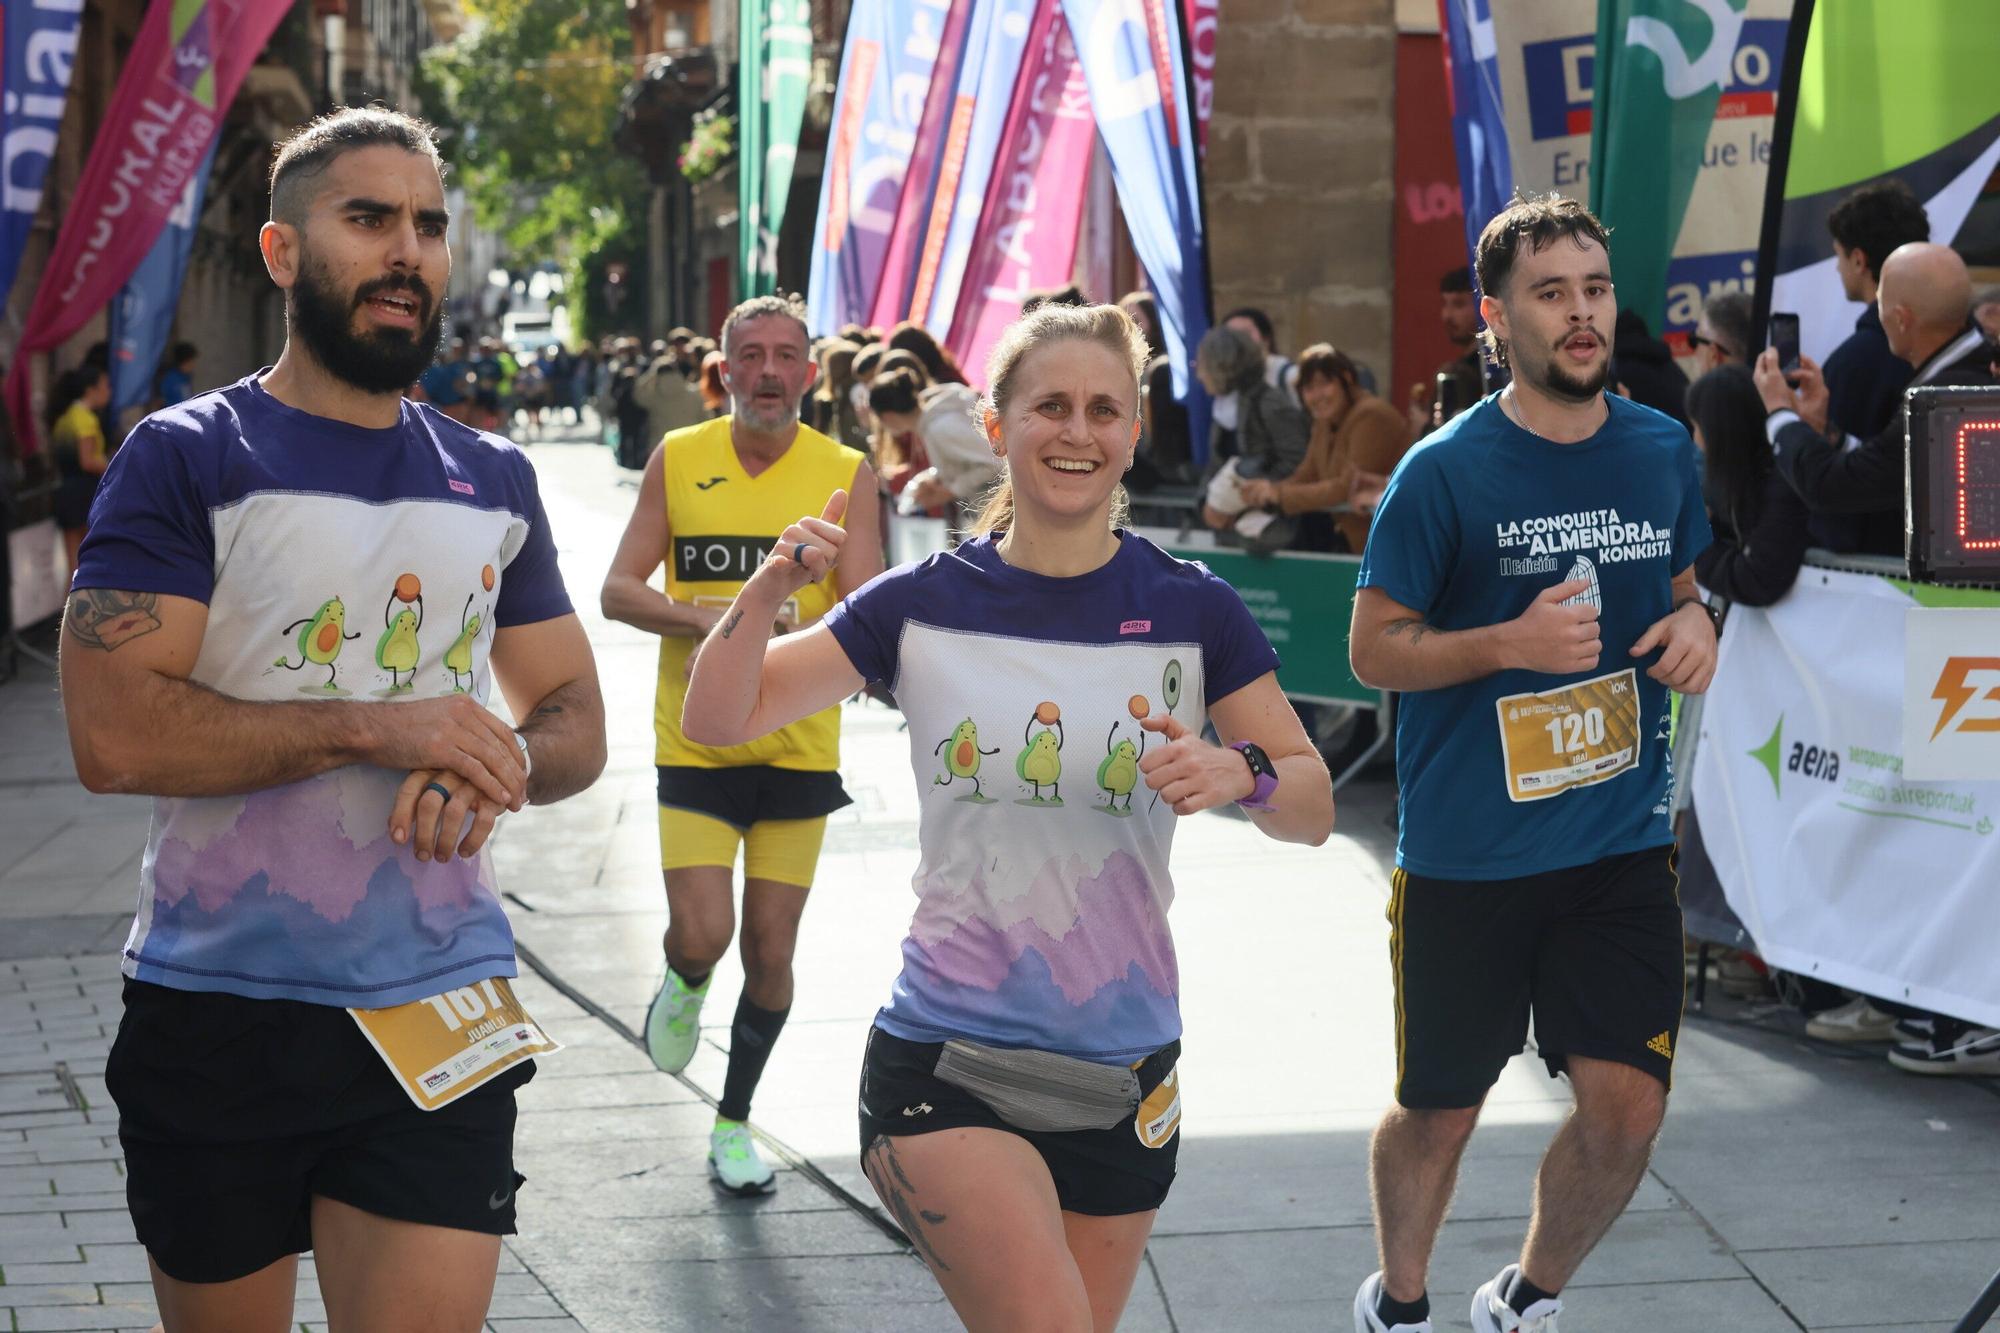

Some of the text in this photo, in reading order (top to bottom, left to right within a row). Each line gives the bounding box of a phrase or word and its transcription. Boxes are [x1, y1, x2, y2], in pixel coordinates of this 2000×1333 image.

[3, 0, 85, 213] Dia
[1702, 142, 1739, 168] ue
[1496, 508, 1620, 538] LA CONQUISTA
[1498, 521, 1671, 556] DE LA ALMENDRA REN
[1599, 540, 1671, 564] KONKISTA
[1512, 555, 1558, 576] Edición
[1545, 707, 1605, 755] 120
[1788, 741, 1840, 783] aena
[467, 1015, 507, 1043] JUANLU
